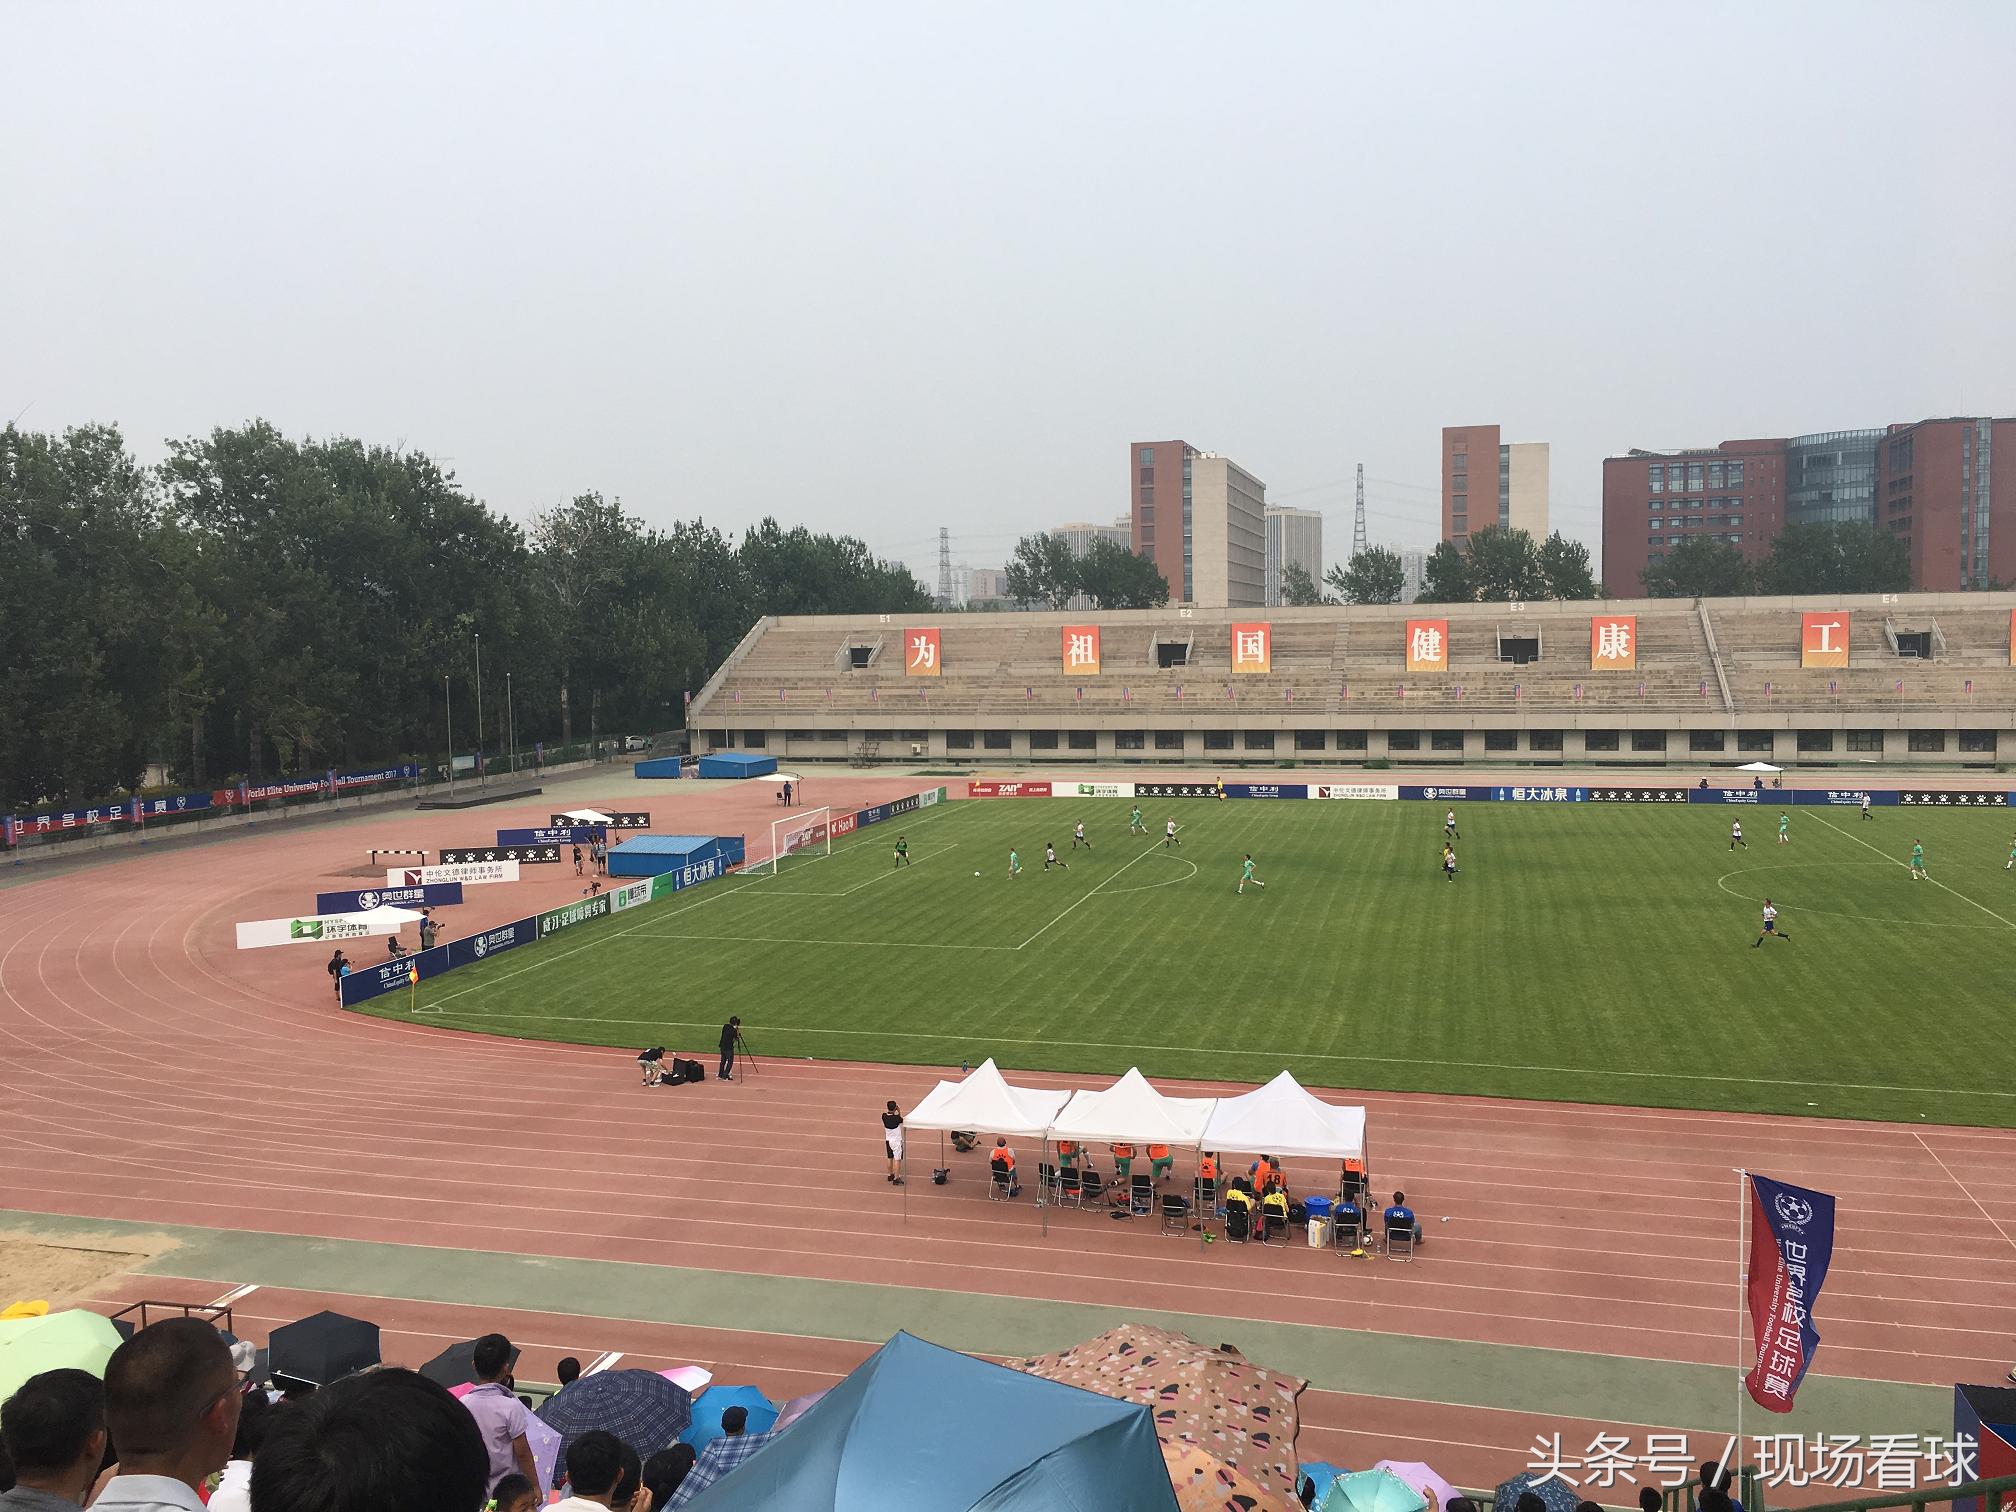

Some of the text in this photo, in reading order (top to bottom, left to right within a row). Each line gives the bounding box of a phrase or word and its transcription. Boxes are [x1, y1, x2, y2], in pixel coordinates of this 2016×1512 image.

[1882, 594, 1899, 604] E4
[1510, 602, 1525, 611] E3
[880, 614, 890, 623] E1
[1180, 610, 1193, 618] E2
[910, 621, 1843, 668] 为 祖 国 健 康 工
[266, 785, 283, 796] Elite
[284, 781, 319, 794] University
[346, 772, 385, 784] Tournament
[385, 769, 397, 779] 2017
[998, 784, 1017, 792] ZAN
[1511, 788, 1568, 801] 恒大冰泉
[534, 829, 571, 837] 信中利
[426, 865, 503, 877] 中伦文德律师事务所
[683, 860, 715, 886] 恒大冰泉
[378, 958, 416, 979] 信中利
[1266, 1174, 1281, 1185] 18
[1769, 1274, 1784, 1313] University
[1763, 1239, 1808, 1400] 世界名校足球赛
[1763, 1313, 1777, 1343] Football
